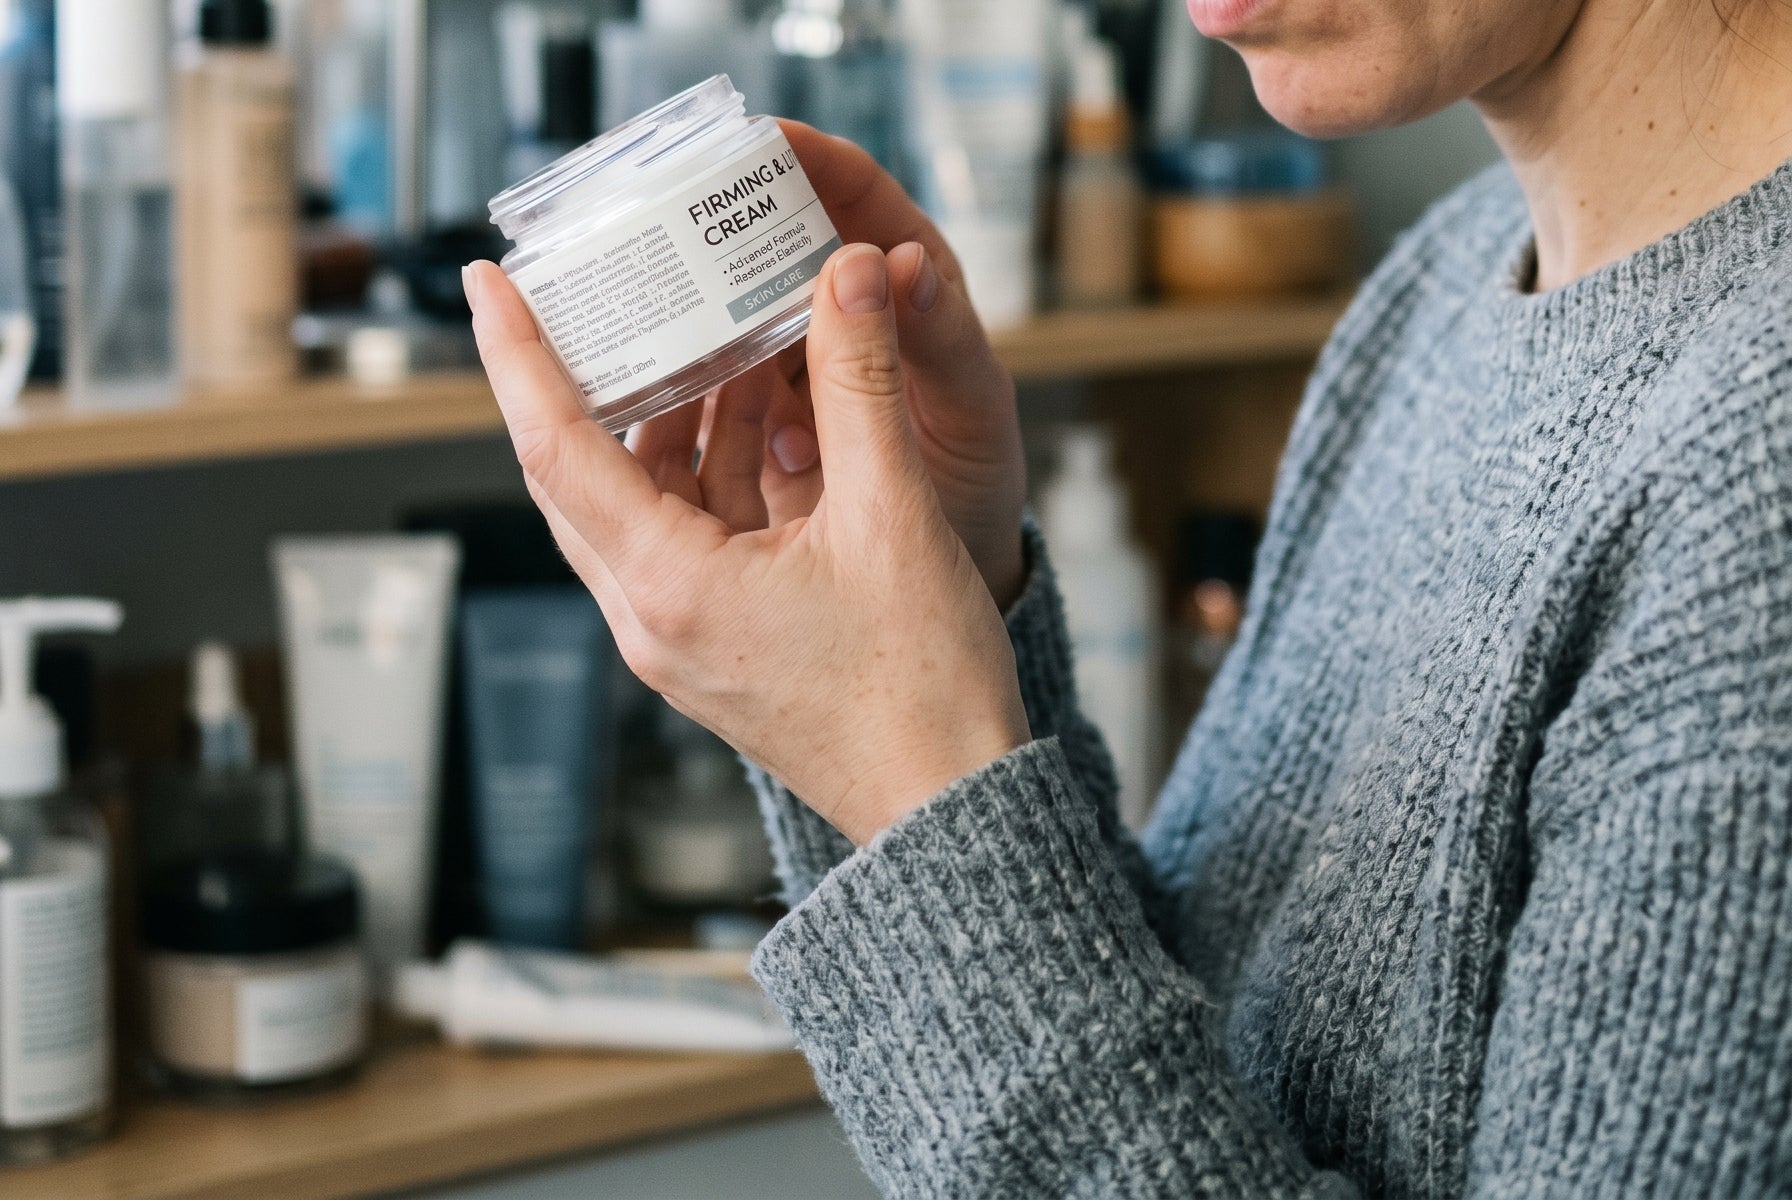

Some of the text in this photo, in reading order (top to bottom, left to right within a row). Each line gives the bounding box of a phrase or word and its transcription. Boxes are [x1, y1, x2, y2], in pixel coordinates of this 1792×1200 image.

[687, 164, 774, 226] FIRMING
[772, 158, 786, 176] &
[704, 194, 778, 246] CREAM
[733, 257, 777, 286] Restores
[744, 268, 805, 310] SKIN CARE
